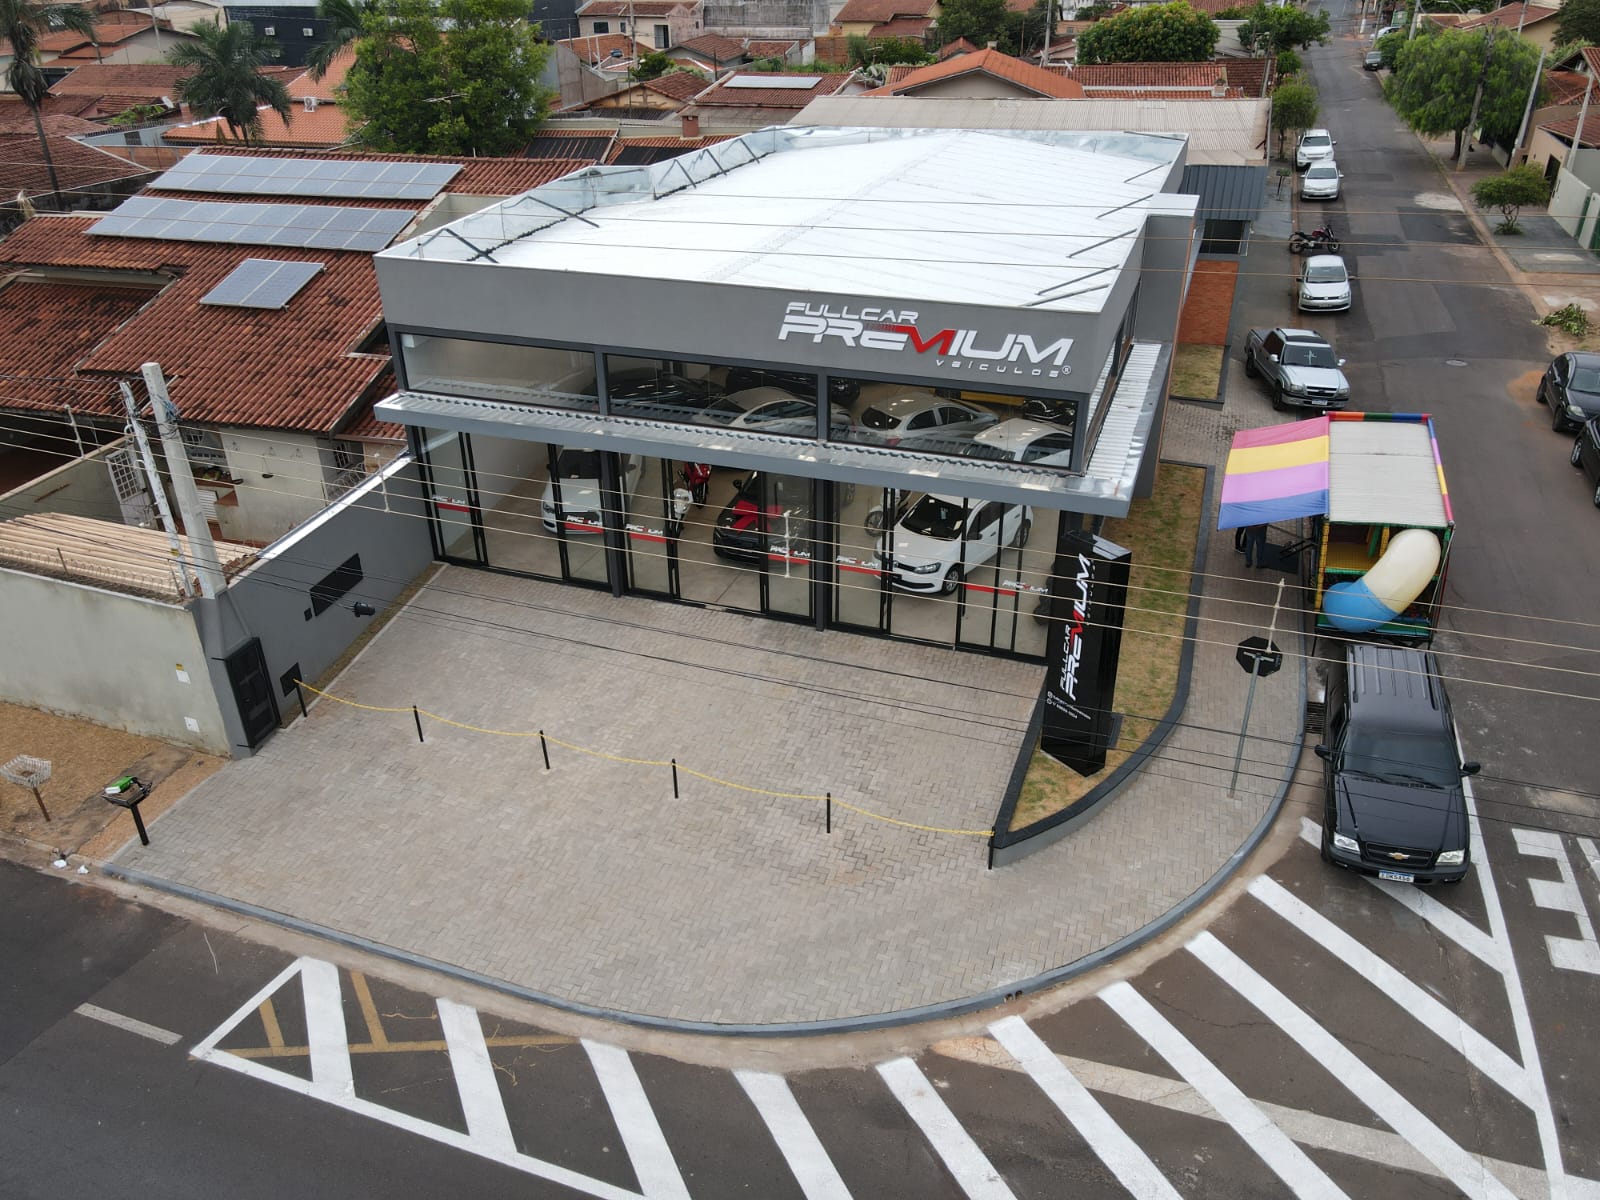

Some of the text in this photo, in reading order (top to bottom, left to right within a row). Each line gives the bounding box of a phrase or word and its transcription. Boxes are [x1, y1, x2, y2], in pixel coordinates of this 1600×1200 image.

[785, 301, 919, 324] FULLCAR
[778, 314, 1074, 366] PREMIUM
[1066, 553, 1091, 701] PREMIUM
